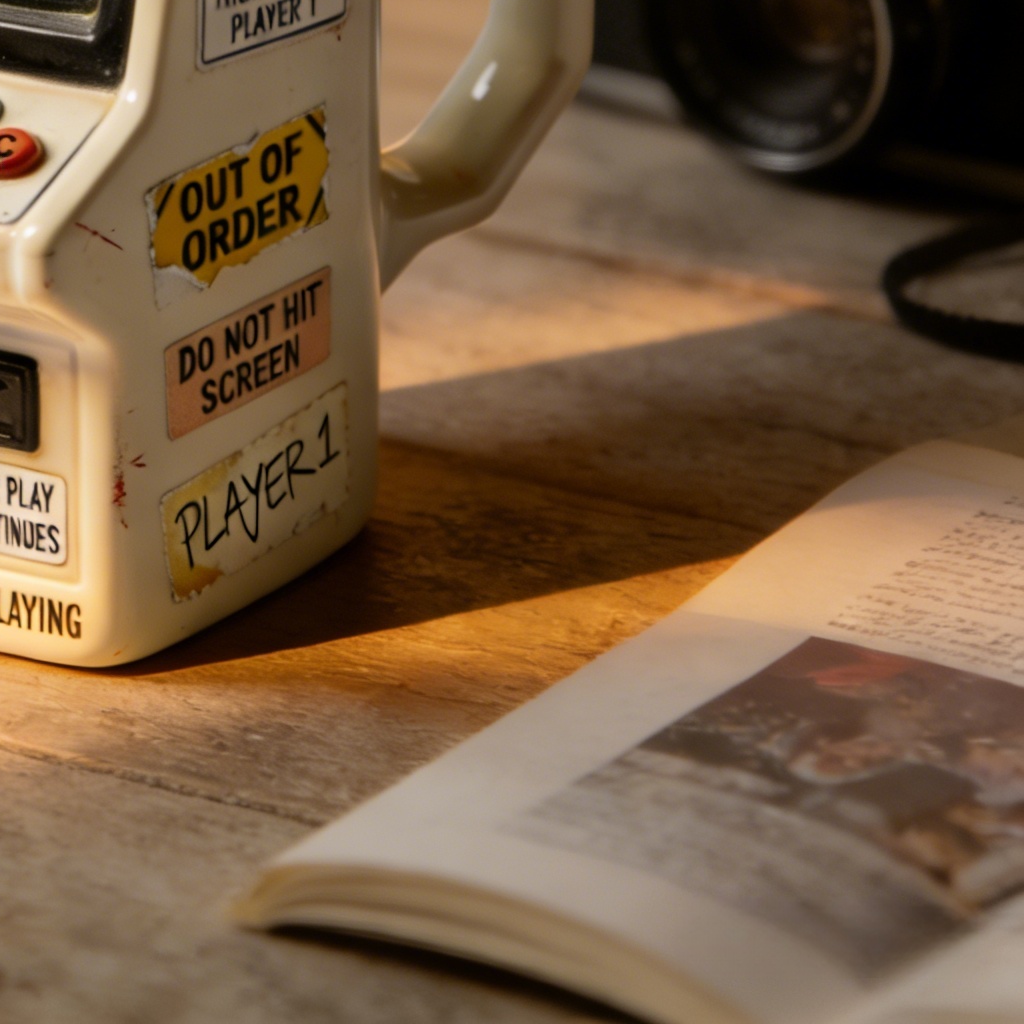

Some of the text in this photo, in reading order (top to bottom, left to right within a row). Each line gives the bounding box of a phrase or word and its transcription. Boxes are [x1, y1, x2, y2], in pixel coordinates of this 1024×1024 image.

[180, 130, 303, 222] OUT OF
[182, 185, 302, 271] ORDER
[179, 281, 323, 385] DO NOT HIT
[201, 334, 300, 414] SCREEN
[6, 476, 54, 513] PLAY
[175, 413, 341, 569] PLAYER 1
